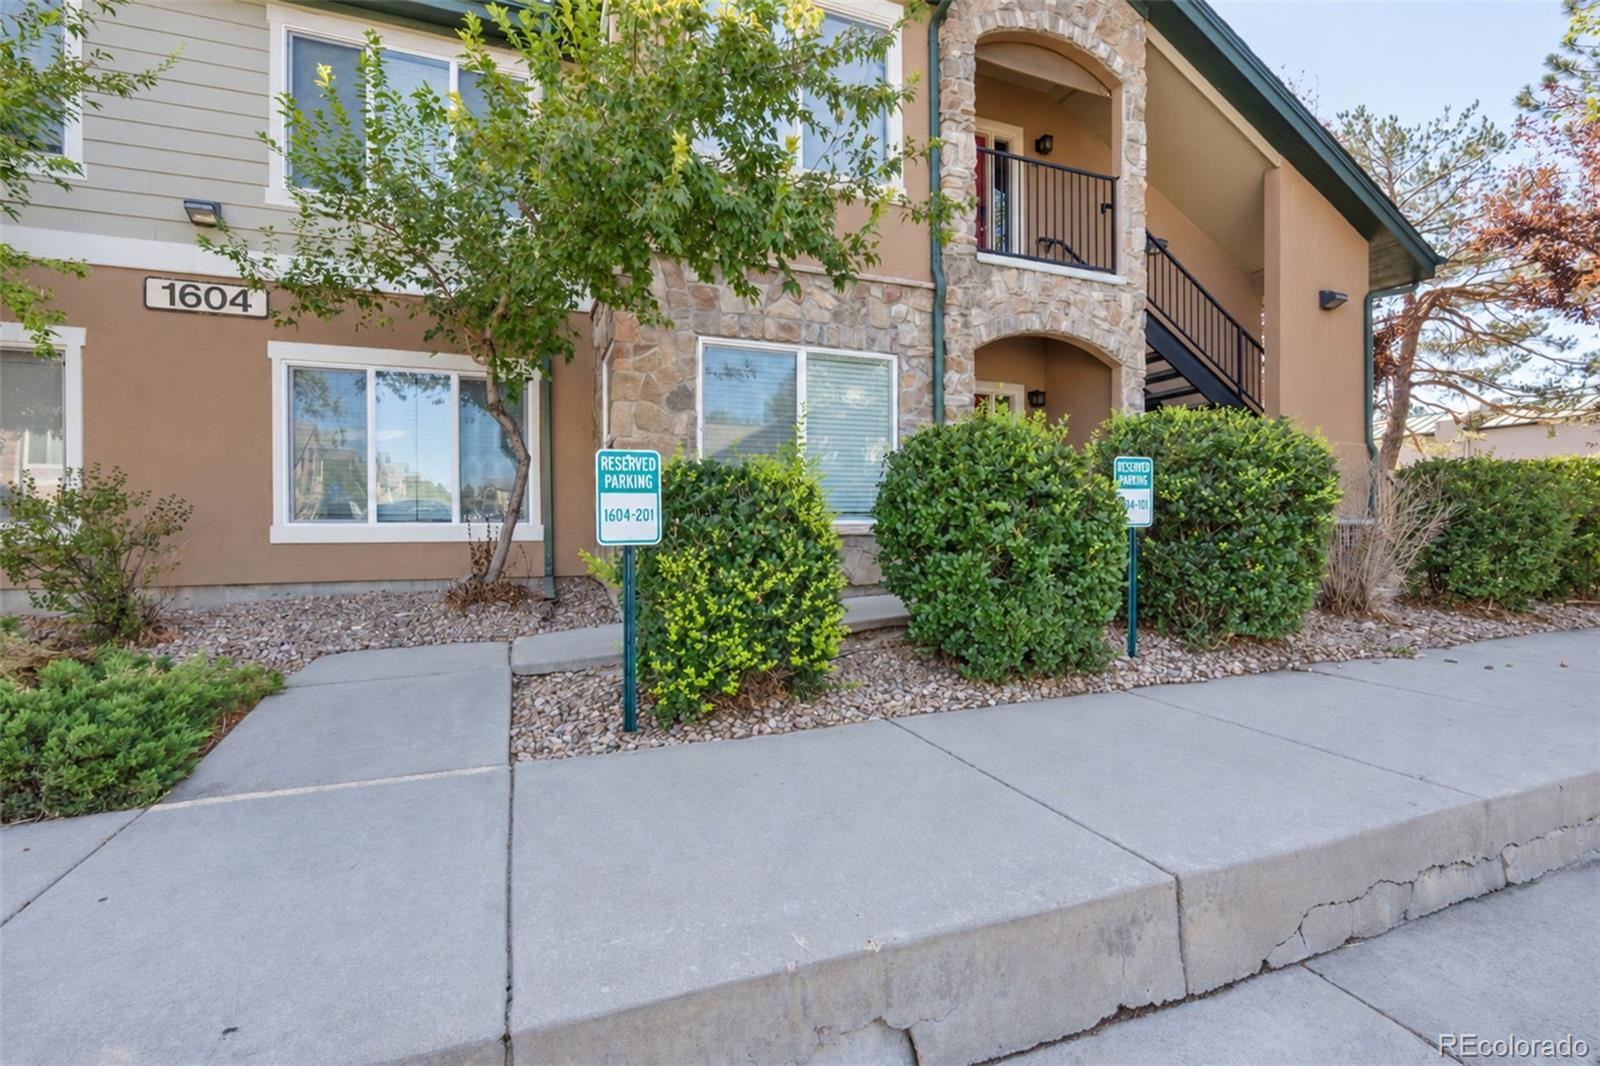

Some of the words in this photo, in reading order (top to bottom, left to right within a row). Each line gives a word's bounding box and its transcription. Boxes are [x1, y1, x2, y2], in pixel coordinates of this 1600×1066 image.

[161, 282, 252, 312] 1604
[601, 455, 656, 471] RESERVED
[1117, 462, 1150, 473] RESERVED
[604, 474, 653, 489] PARKING
[1119, 474, 1148, 486] PARKING
[604, 508, 654, 522] 1604-201
